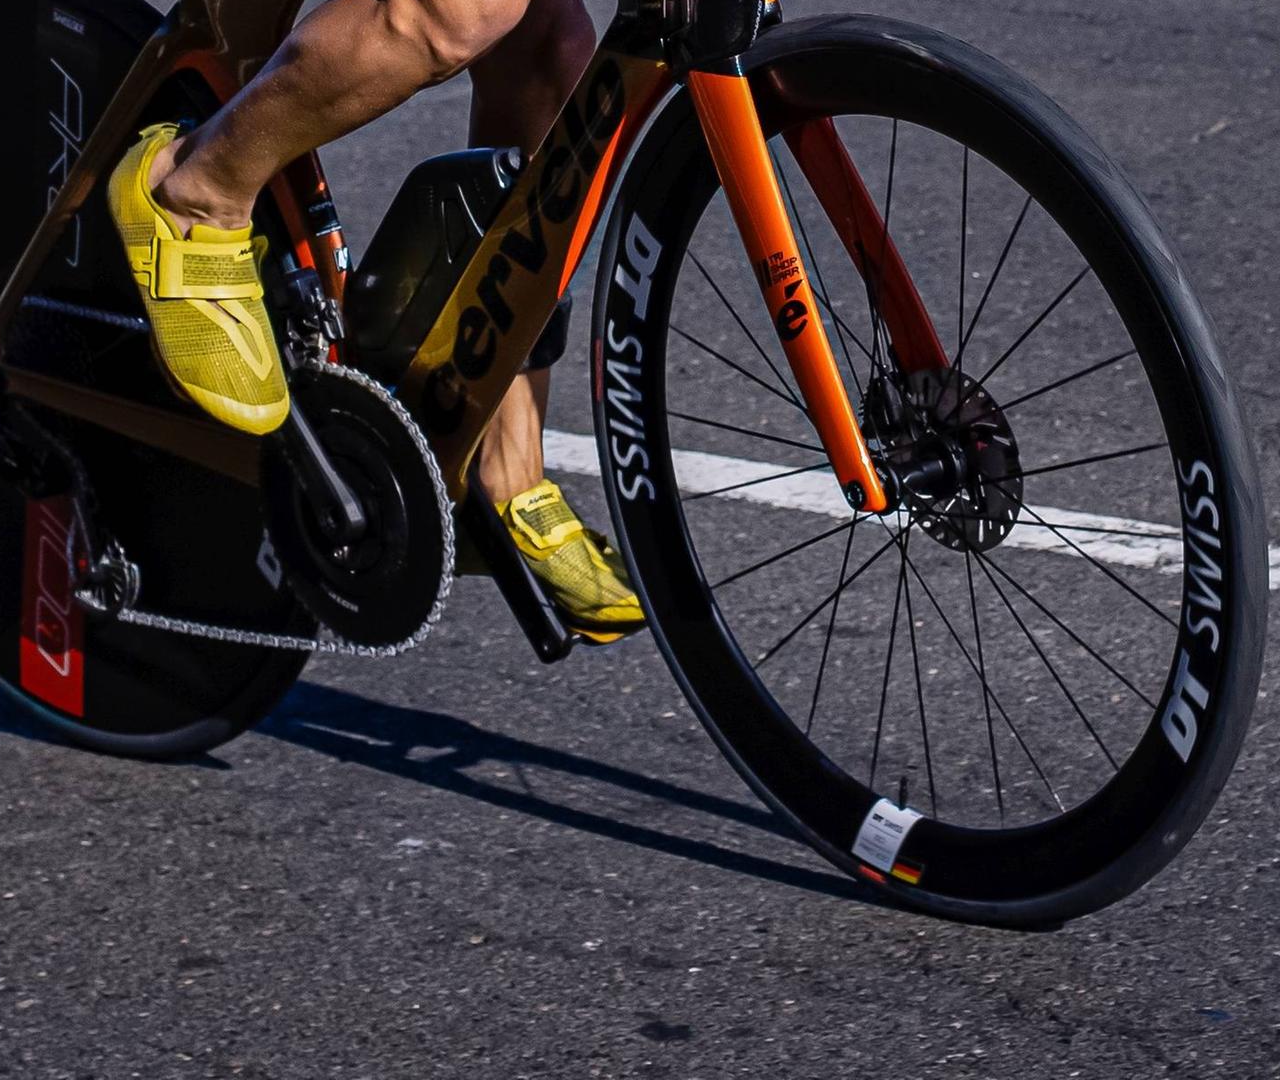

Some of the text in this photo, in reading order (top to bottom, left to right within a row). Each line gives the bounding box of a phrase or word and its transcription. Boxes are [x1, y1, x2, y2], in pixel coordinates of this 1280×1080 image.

[606, 211, 662, 502] DT SWISS
[1162, 459, 1222, 763] DT SWISS
